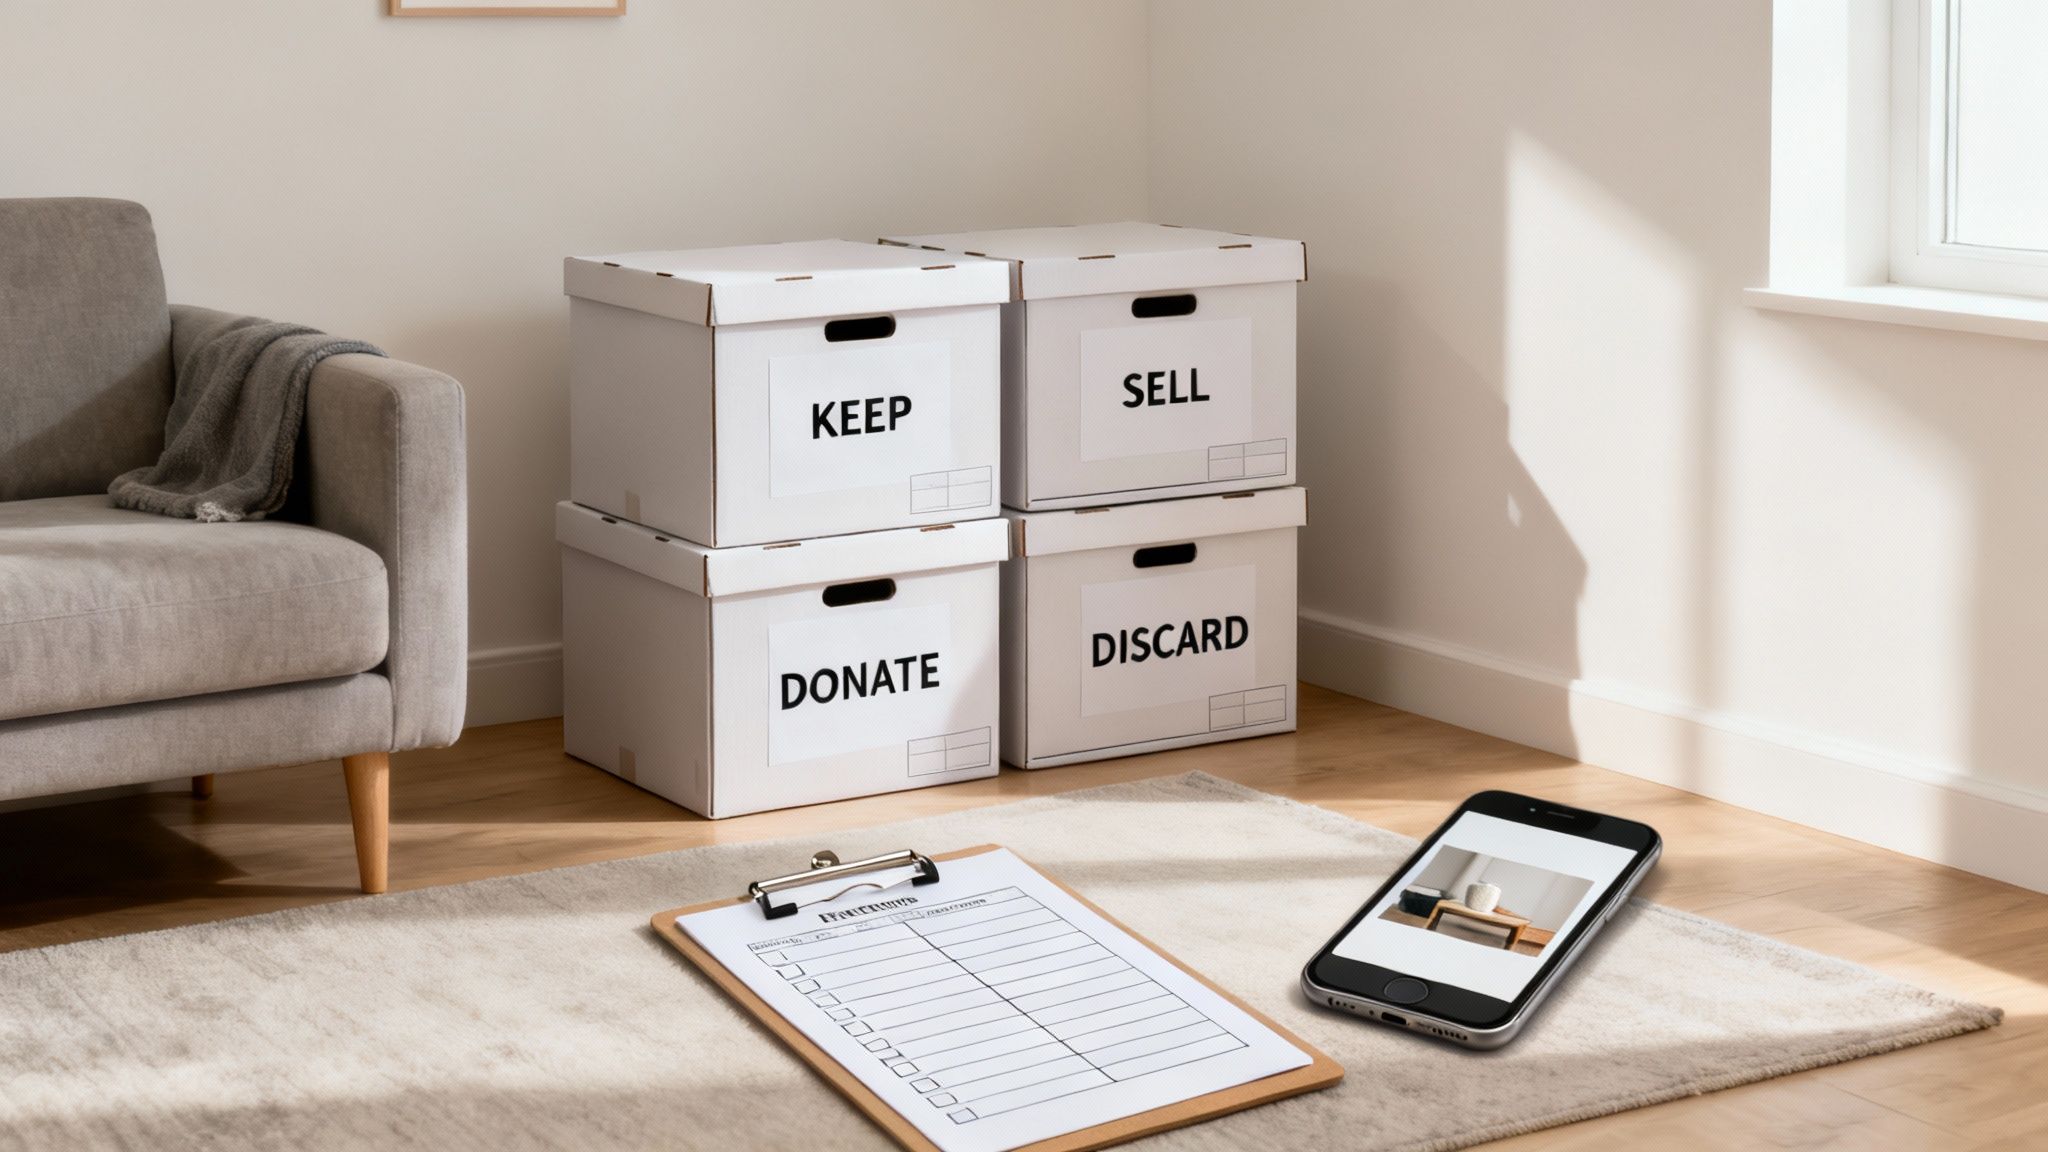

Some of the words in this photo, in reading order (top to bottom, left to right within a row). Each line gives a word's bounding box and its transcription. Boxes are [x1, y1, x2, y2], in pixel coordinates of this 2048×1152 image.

[1122, 366, 1210, 409] SELL
[812, 394, 912, 440] KEEP
[1092, 614, 1249, 669] DISCARD
[780, 652, 940, 711] DONATE
